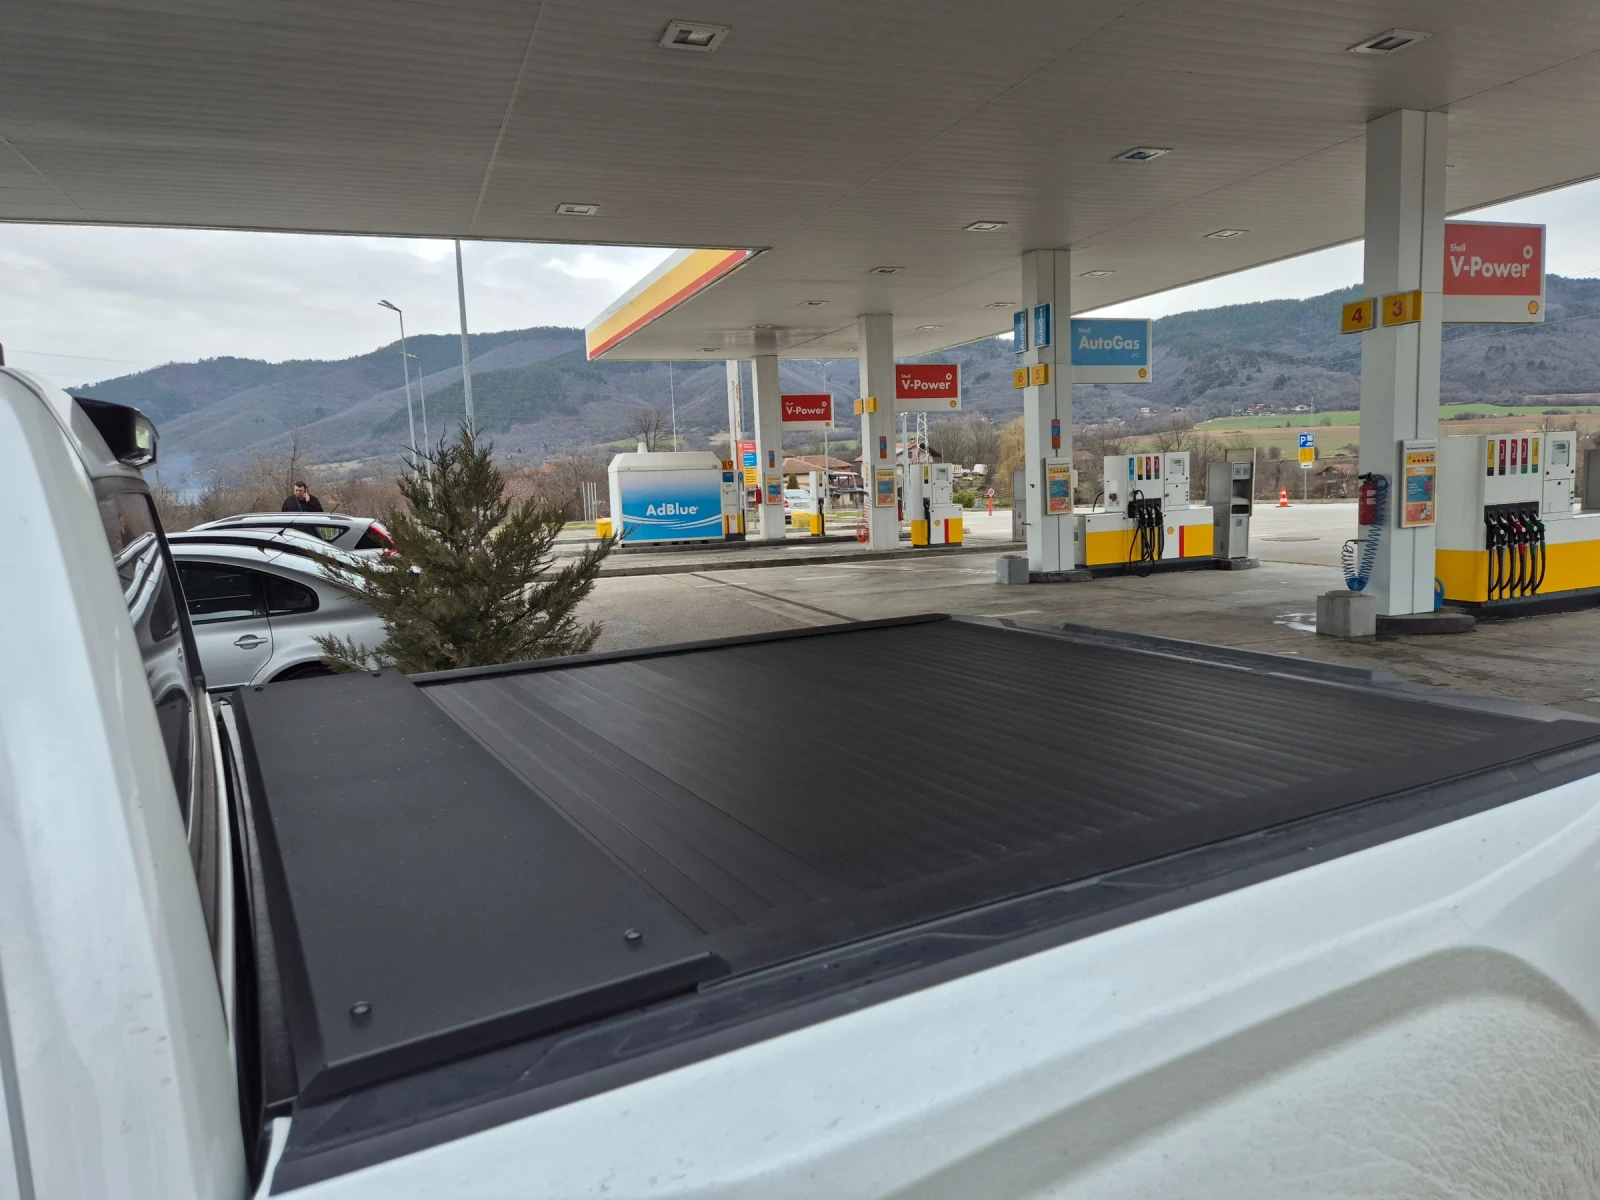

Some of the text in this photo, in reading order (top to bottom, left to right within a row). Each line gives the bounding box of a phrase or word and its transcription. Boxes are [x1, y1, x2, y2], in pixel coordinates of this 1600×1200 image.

[1449, 243, 1466, 252] Shell
[1449, 255, 1530, 278] V-Power
[1392, 300, 1403, 318] 3
[1351, 307, 1363, 324] 4
[1079, 335, 1140, 350] AutoGas
[1018, 372, 1024, 383] 6
[1035, 369, 1041, 380] 5
[901, 379, 951, 390] V-Power
[786, 406, 825, 415] V-Power
[1300, 436, 1307, 445] P
[646, 502, 698, 516] AdBlue
